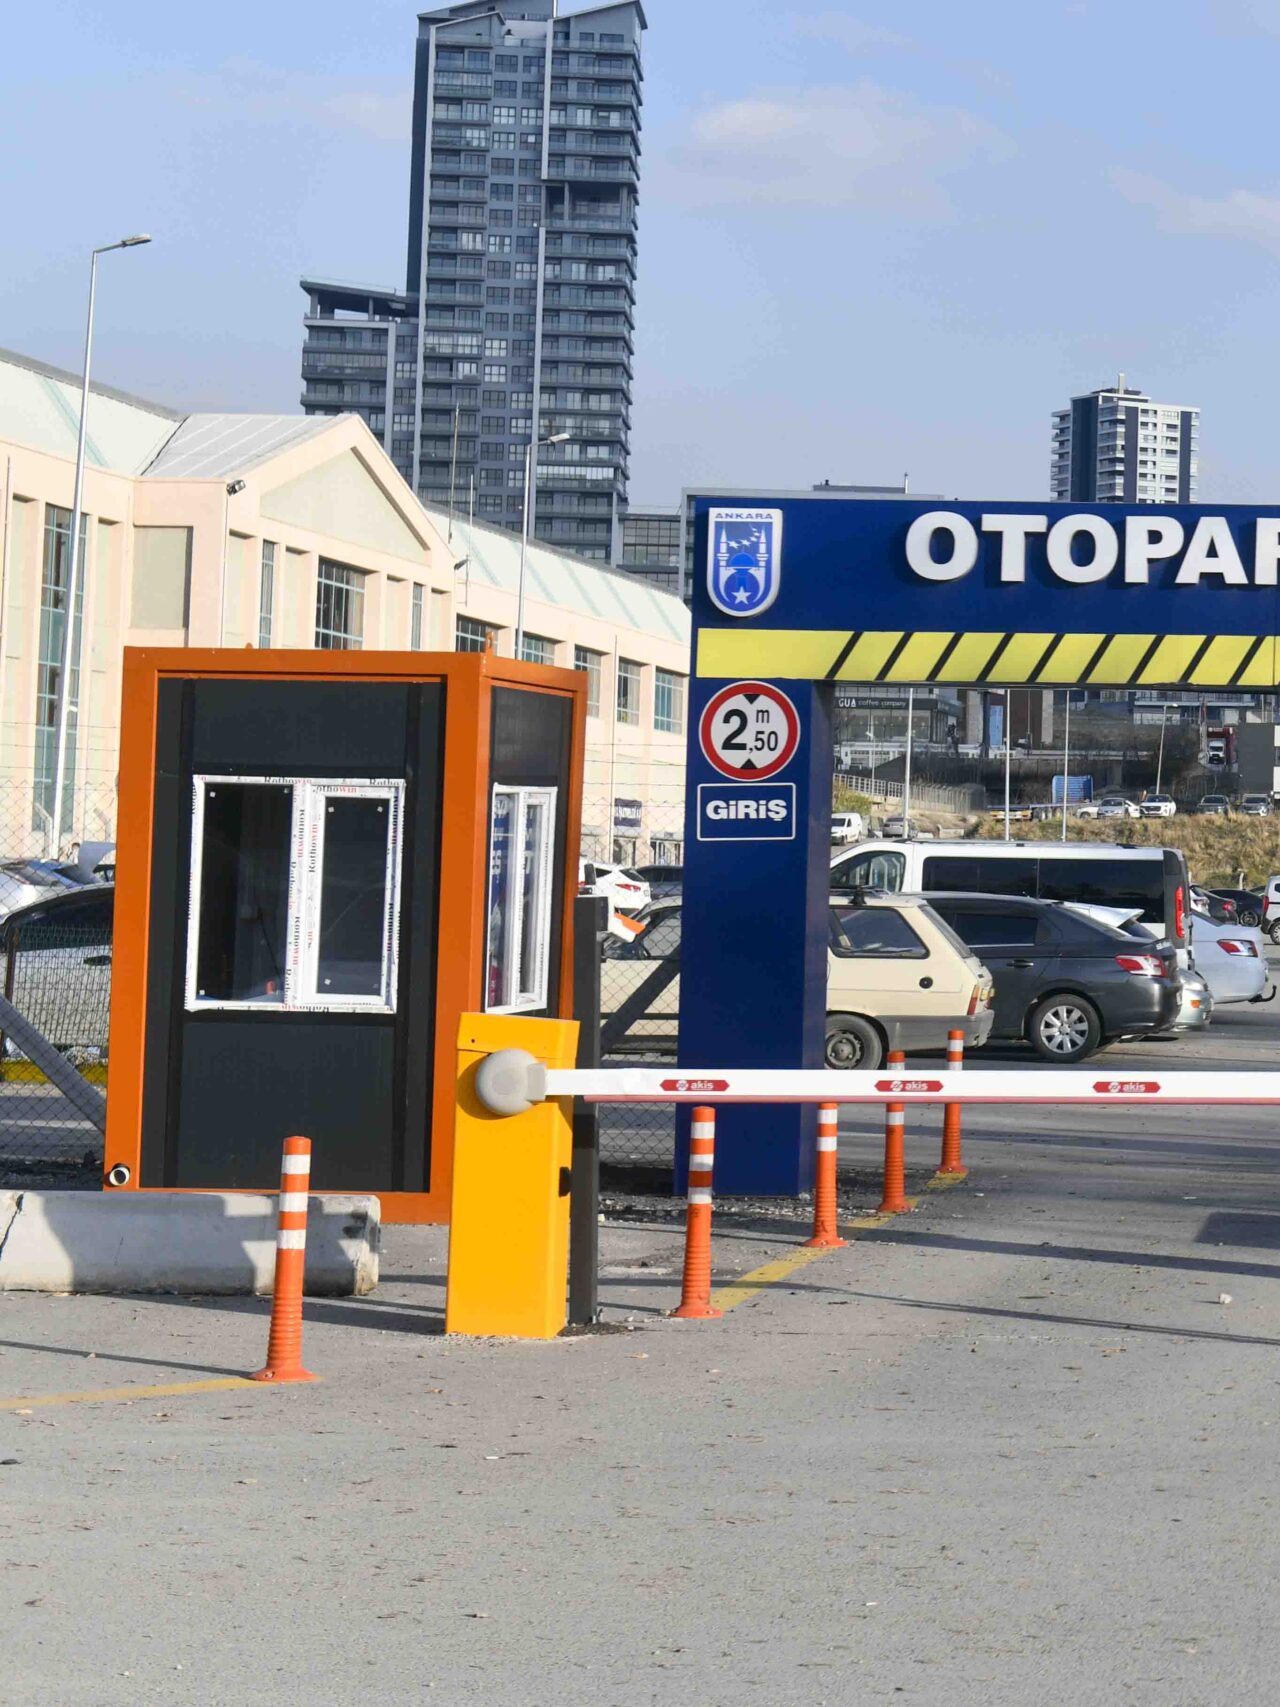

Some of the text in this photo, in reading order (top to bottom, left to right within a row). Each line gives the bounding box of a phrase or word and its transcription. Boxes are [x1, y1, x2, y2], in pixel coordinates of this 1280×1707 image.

[858, 699, 879, 707] coffee
[881, 700, 907, 708] company
[690, 1080, 714, 1089] akis
[905, 1080, 928, 1090] akis
[1122, 1082, 1145, 1092] akis
